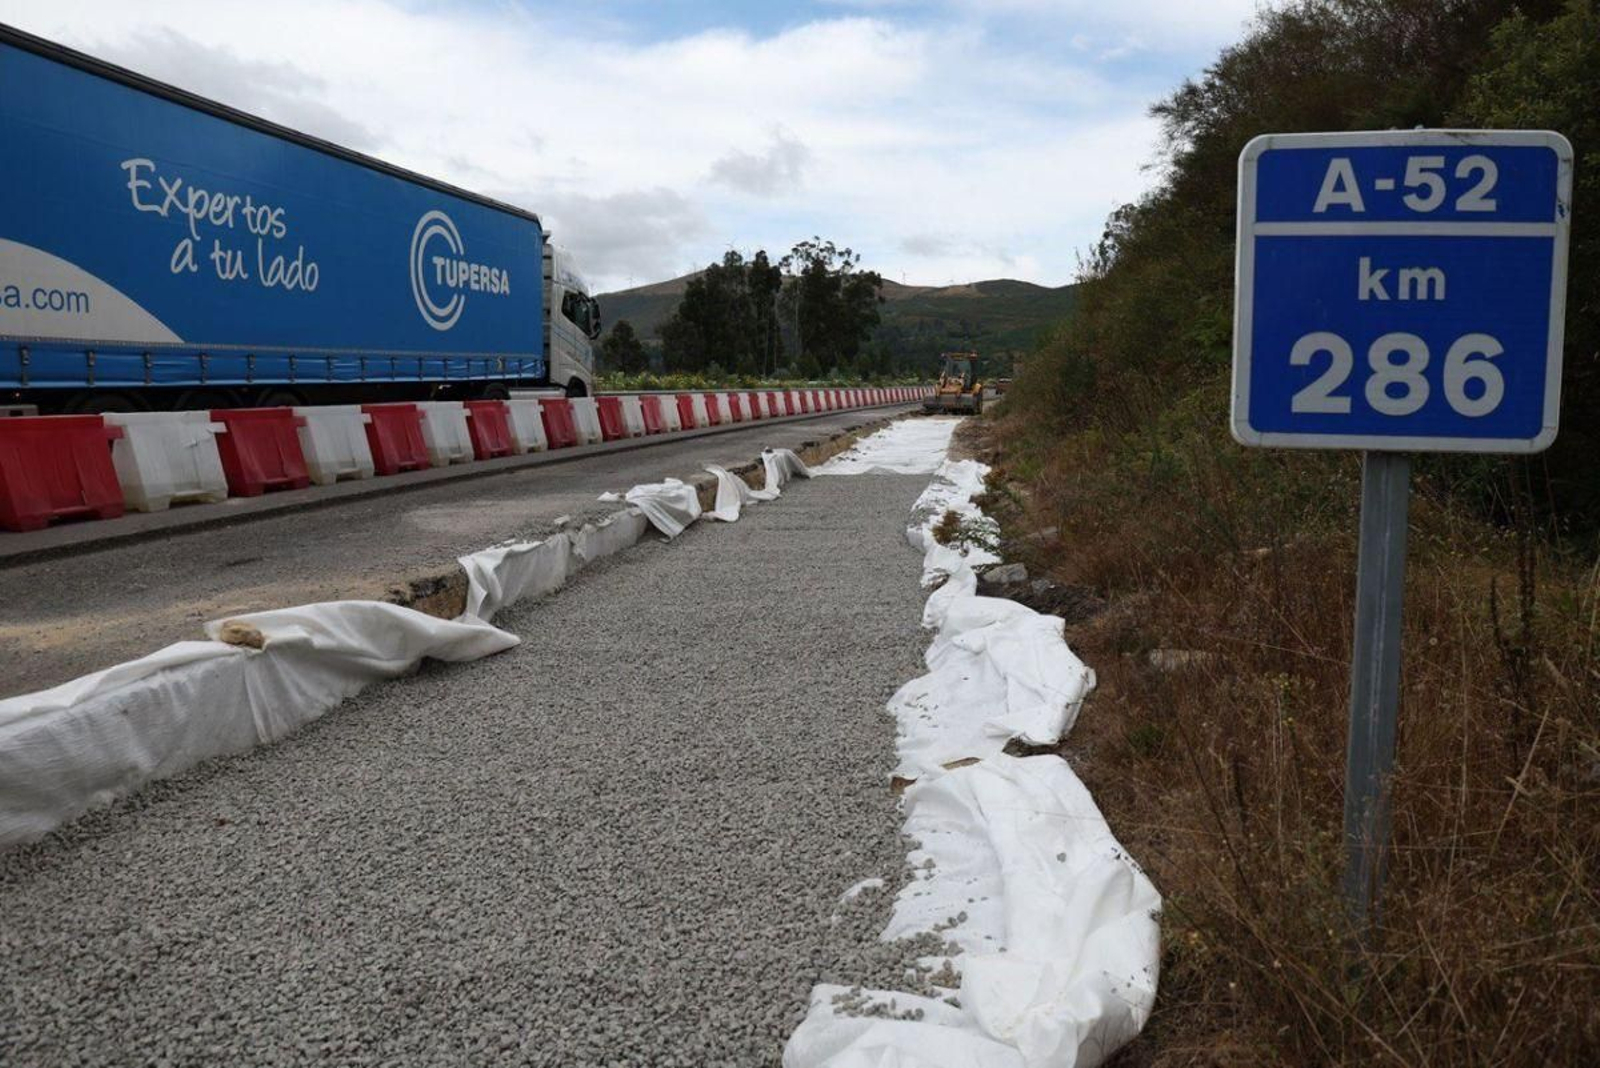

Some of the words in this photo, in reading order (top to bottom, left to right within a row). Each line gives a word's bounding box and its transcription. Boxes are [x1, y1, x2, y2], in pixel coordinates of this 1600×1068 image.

[120, 158, 287, 240] Expertos
[1312, 155, 1499, 213] A-52
[170, 238, 198, 274] a
[210, 239, 248, 280] tu
[258, 237, 319, 292] lado
[432, 256, 510, 295] TUPERSA
[1358, 256, 1446, 300] km
[0, 285, 89, 313] a.com
[1289, 331, 1505, 417] 286
